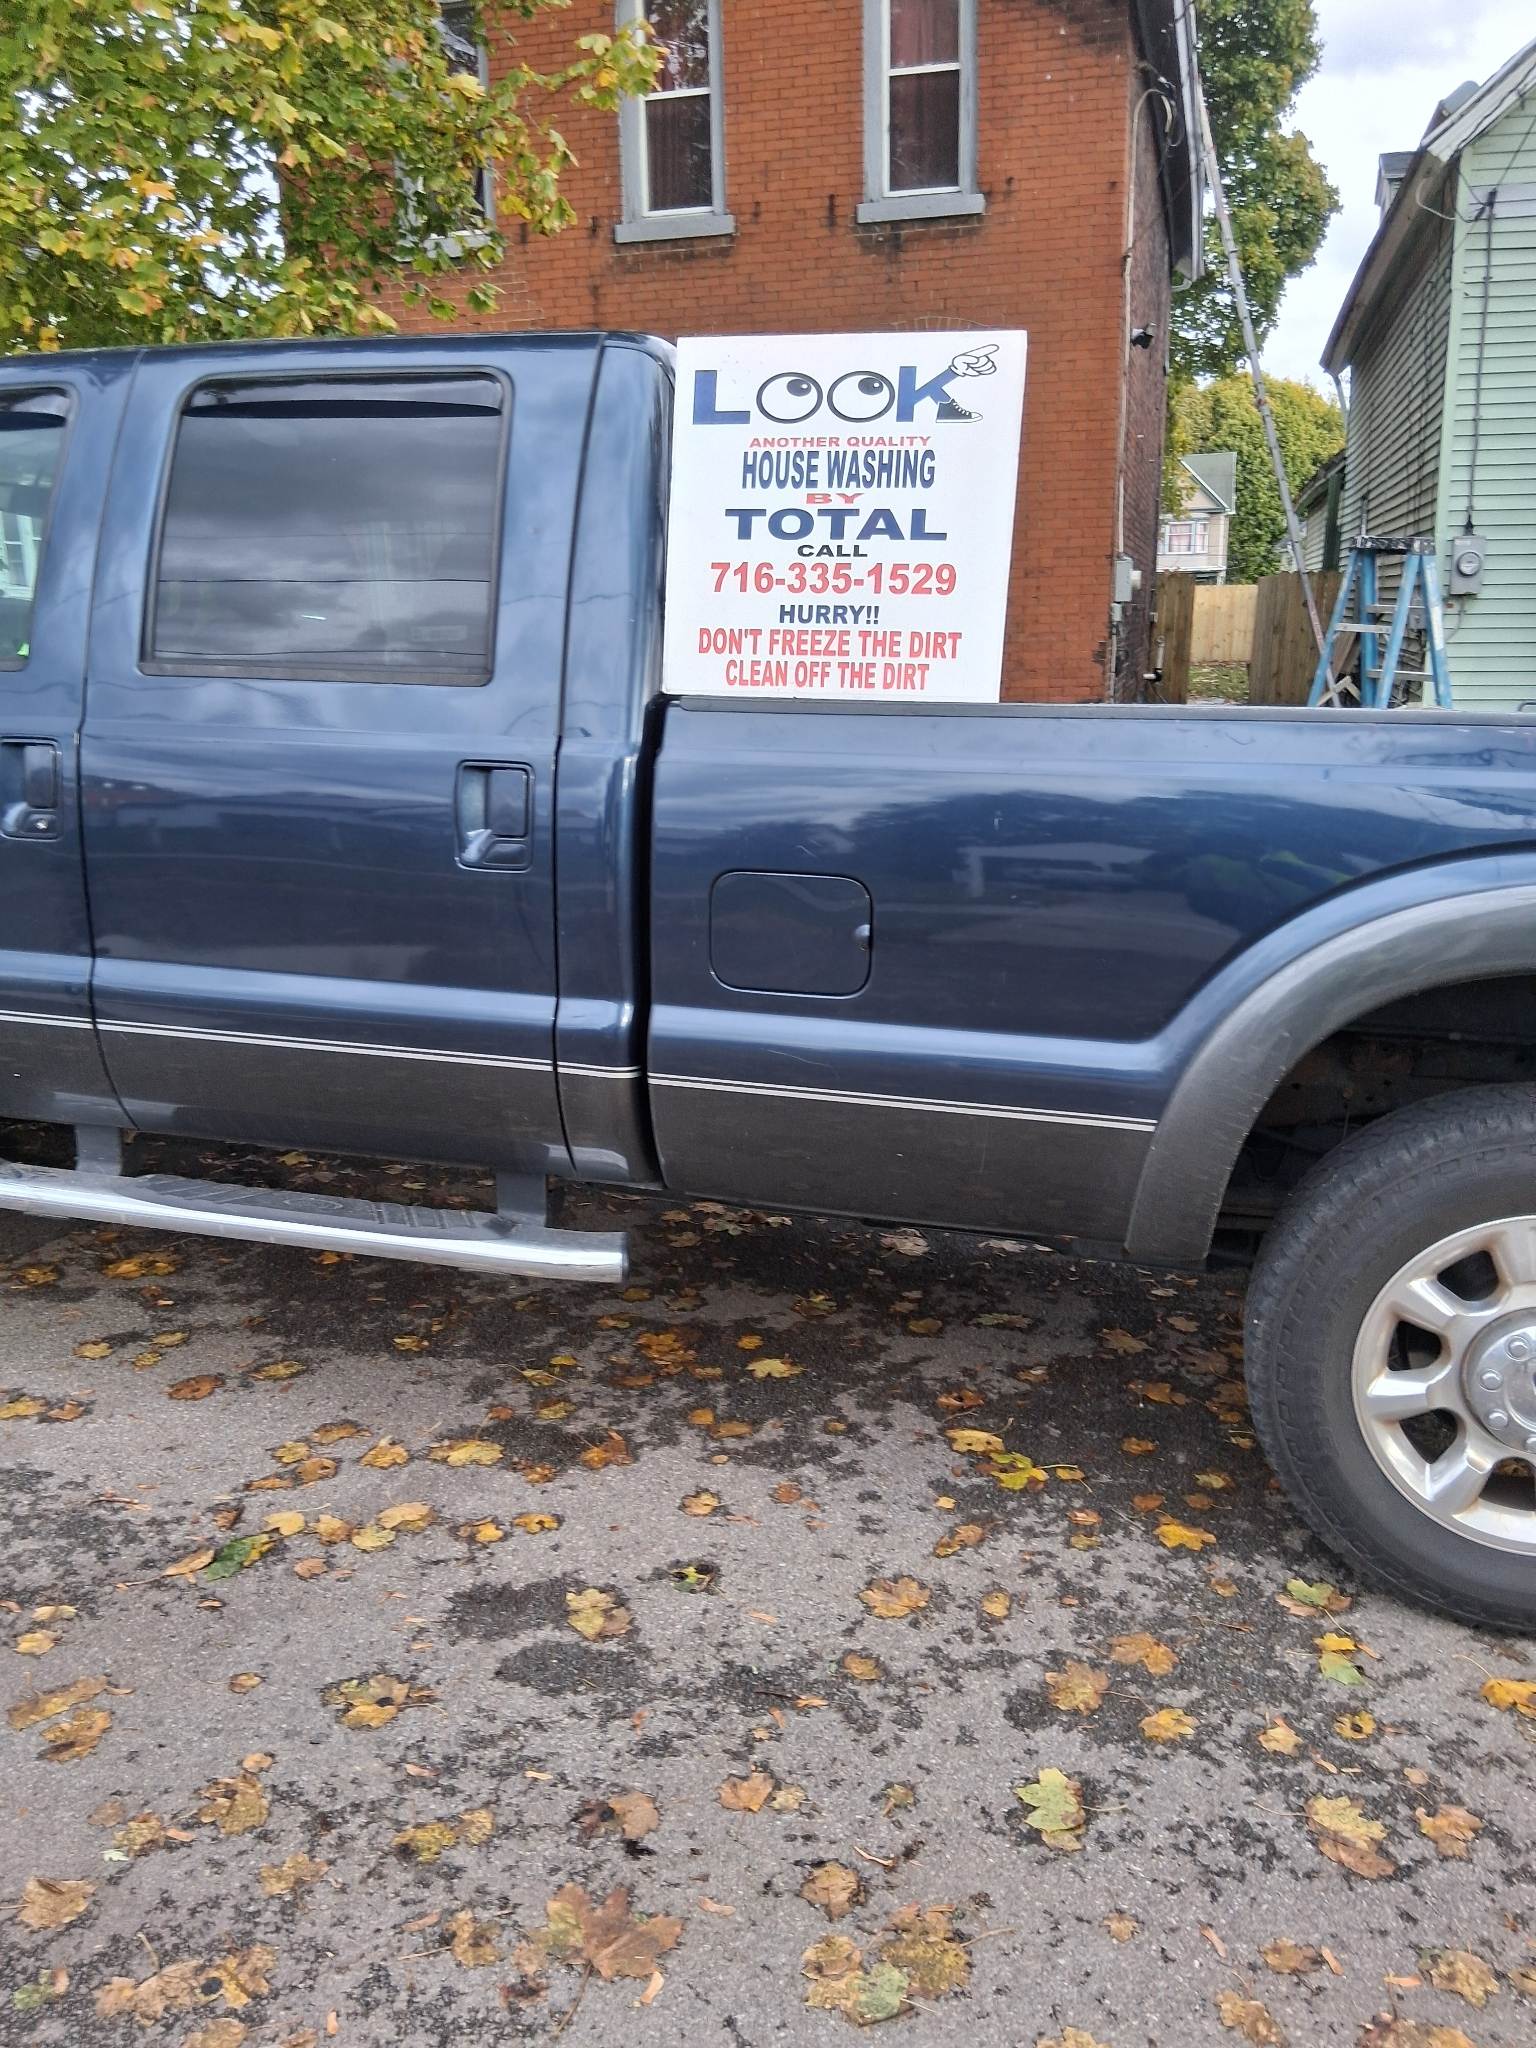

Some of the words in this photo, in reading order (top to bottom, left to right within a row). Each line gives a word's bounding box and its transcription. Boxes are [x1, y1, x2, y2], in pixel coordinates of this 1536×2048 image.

[692, 355, 992, 425] LOOK
[749, 436, 841, 449] ANOTHER
[847, 435, 932, 447] QUALITY
[741, 450, 820, 489] HOUSE
[826, 449, 936, 489] WASHING
[806, 493, 865, 505] BY
[724, 508, 948, 541] TOTAL
[797, 544, 868, 558] CALL
[710, 562, 957, 596] 716-335-1529
[779, 604, 880, 625] HURRY!!
[698, 627, 763, 655] DON'T
[768, 629, 850, 657] FREEZE
[858, 630, 901, 658] THE
[909, 631, 963, 659] DIRT
[725, 659, 789, 687] CLEAN
[794, 661, 831, 688] OFF
[837, 662, 877, 689] THE
[882, 663, 930, 690] DIRT
